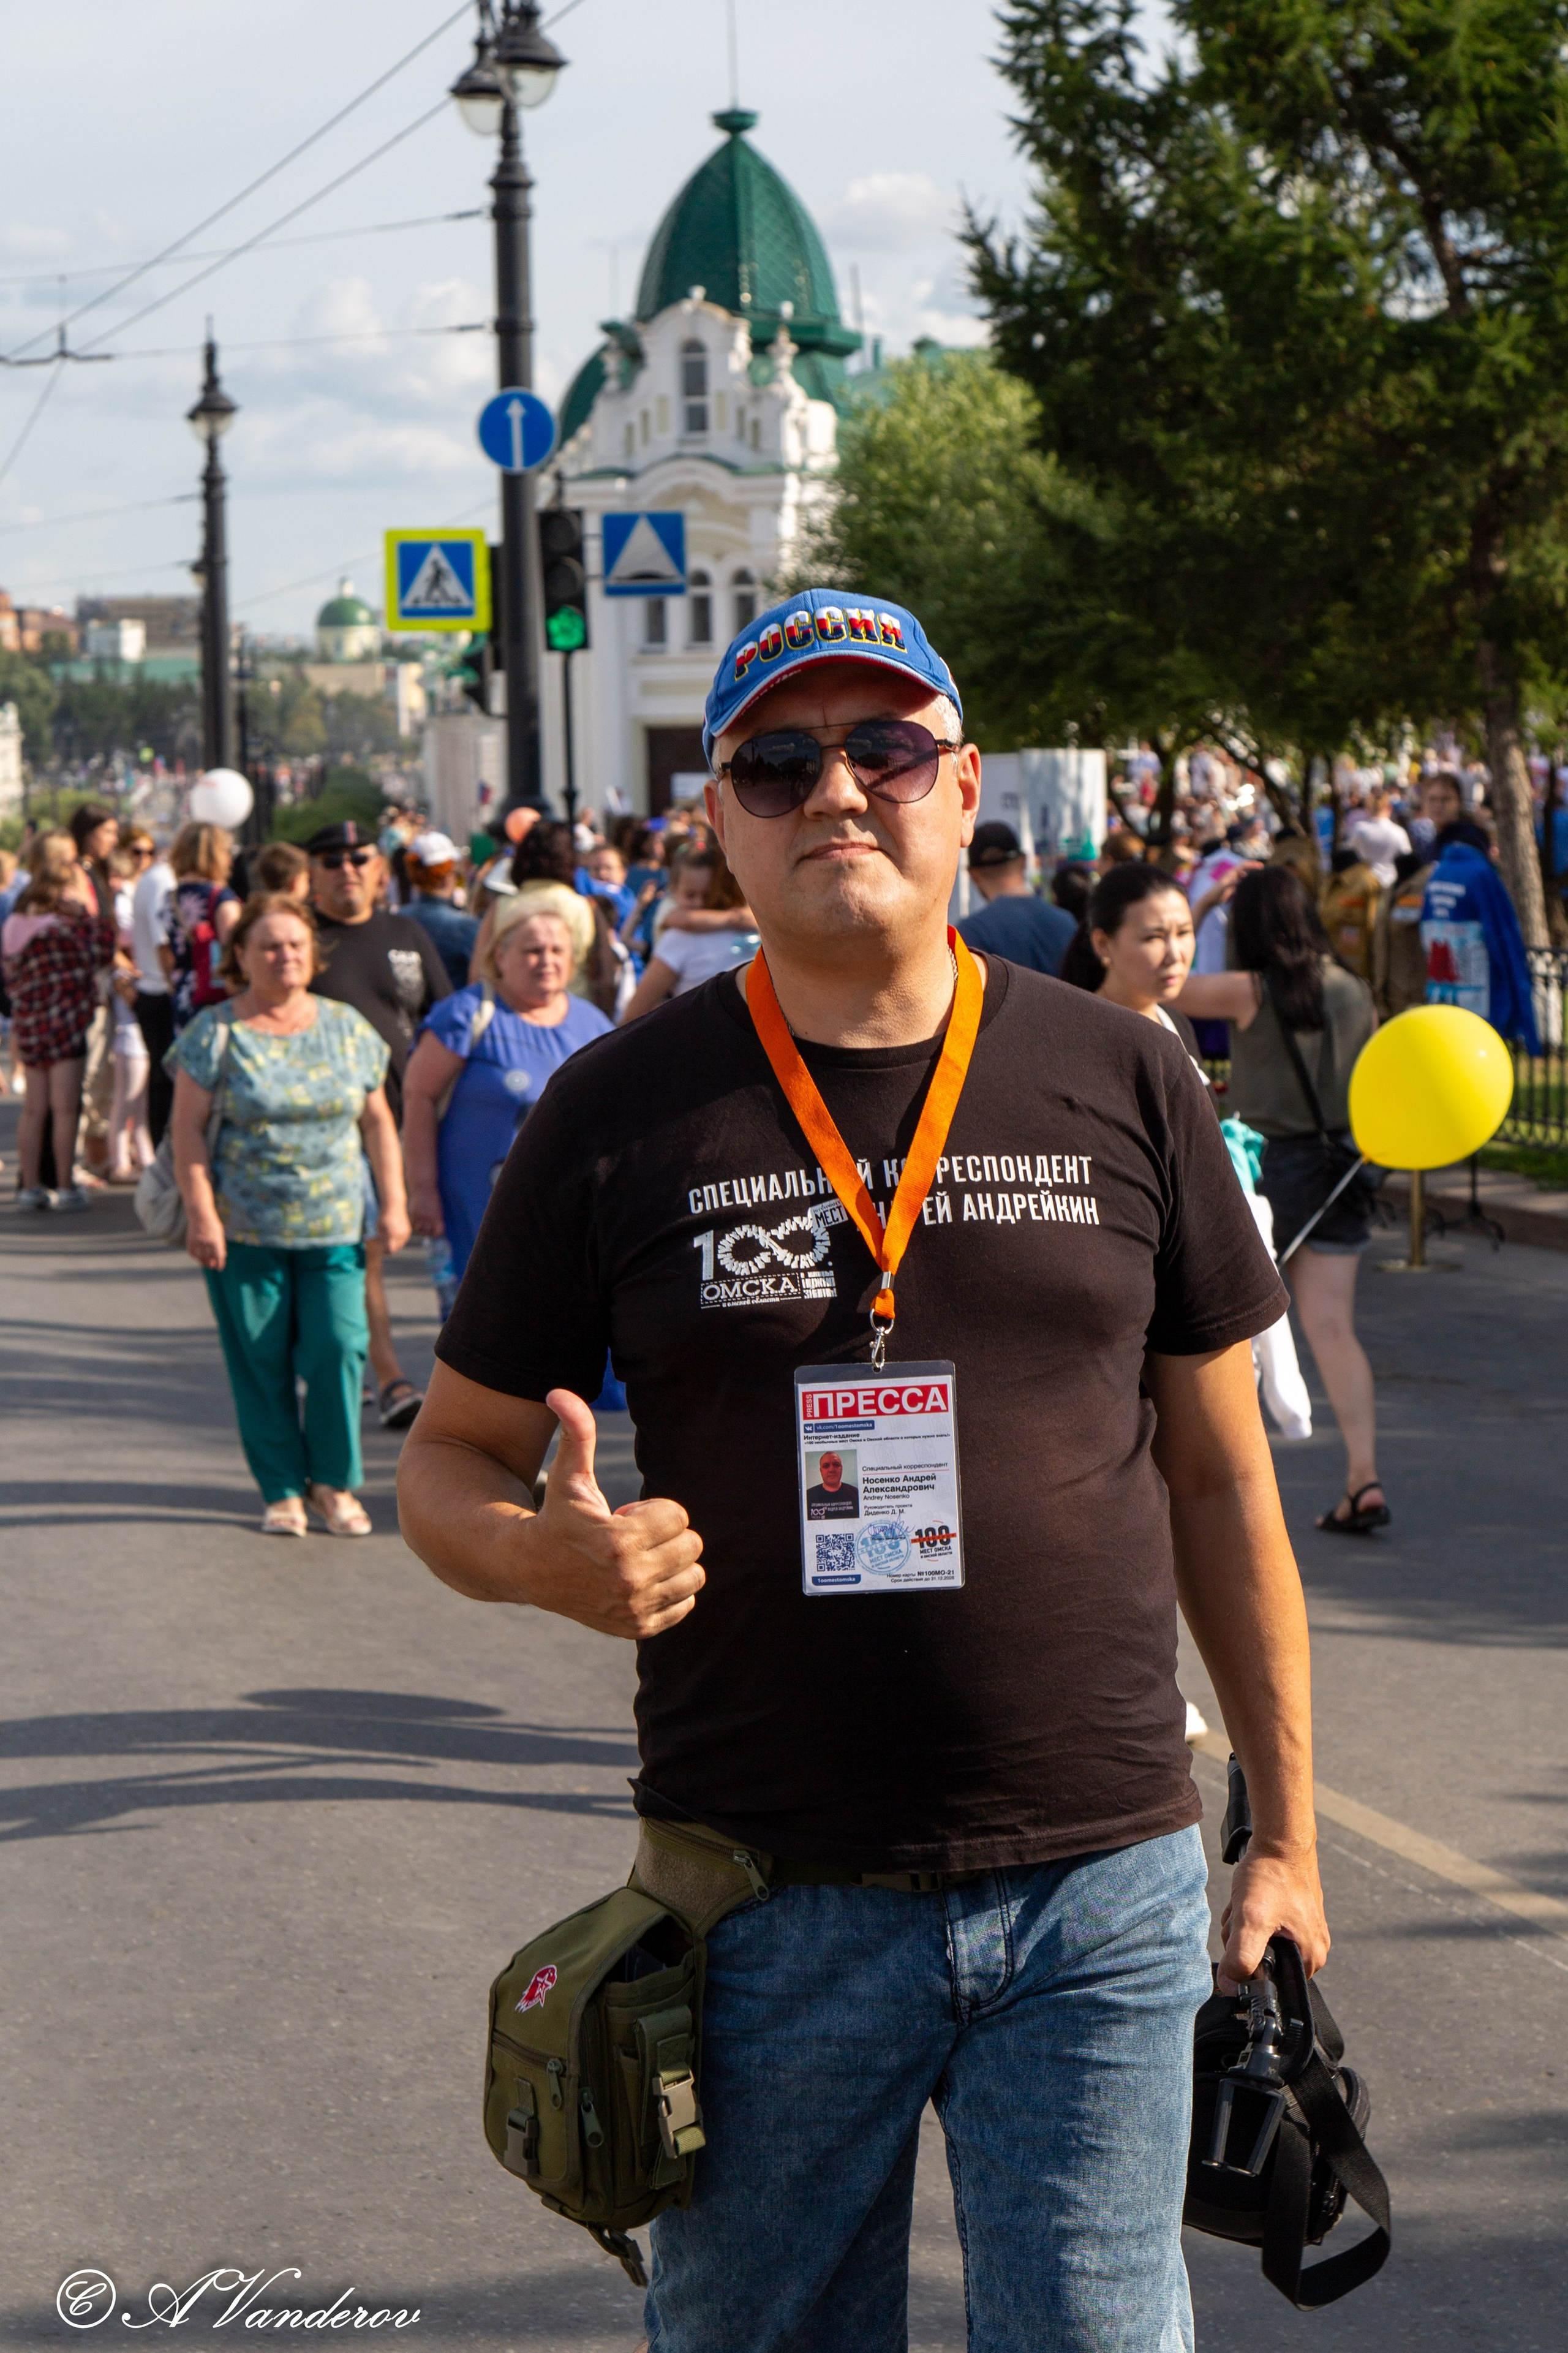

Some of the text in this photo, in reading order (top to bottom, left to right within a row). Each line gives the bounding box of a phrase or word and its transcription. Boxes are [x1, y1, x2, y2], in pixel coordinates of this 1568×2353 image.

[734, 605, 908, 681] РОССИЯ
[689, 1155, 1092, 1214] СПЕЦИАЛЬНЙ КРЕСПОНДЕНТ
[815, 1206, 844, 1228] МЕСТ
[963, 1190, 1100, 1225] АНДРЕЙКИН
[703, 1277, 798, 1301] ОМСКА
[813, 1386, 947, 1418] ПРЕССА
[863, 1484, 935, 1494] Александрович
[903, 1473, 937, 1482] Андрей
[915, 1525, 951, 1549] 100
